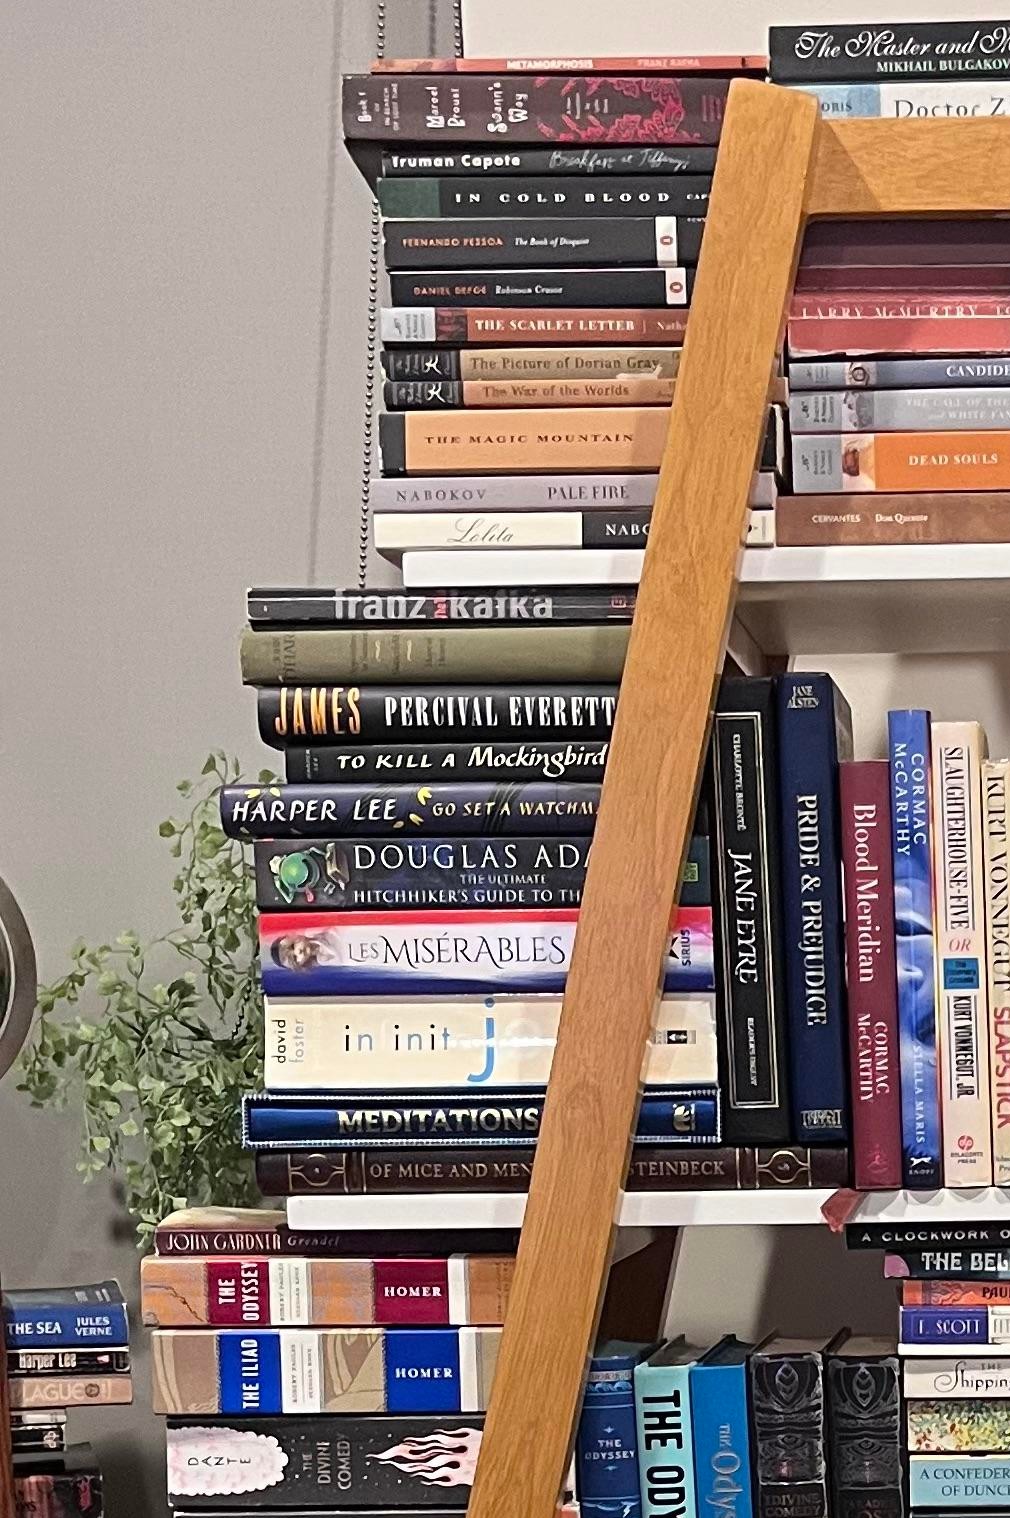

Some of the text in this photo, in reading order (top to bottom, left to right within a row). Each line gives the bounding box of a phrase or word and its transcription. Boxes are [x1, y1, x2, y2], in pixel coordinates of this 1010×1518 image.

[794, 31, 840, 61] The
[845, 30, 931, 57] Master
[935, 30, 978, 55] and
[877, 58, 1010, 73] MIKHAIL BULGAKOV
[392, 154, 521, 168] Truman Capote
[456, 192, 670, 203] IN COLD BLOOD
[475, 319, 635, 331] THE SCARLET LETTER
[424, 433, 634, 445] THE MAGIC MOUNTAIN
[908, 453, 998, 466] DEAD SOULS
[274, 687, 615, 736] JAMES PERCIVAL EVERETT
[337, 747, 607, 777] TO KILL A Mockingbird
[232, 799, 396, 822] HARPER LEE
[944, 746, 970, 930] SLAUGHTERHOUSE-FIVE
[355, 843, 517, 870] DOUGLAS
[853, 803, 876, 983] Blood Meridian
[728, 848, 758, 984] JANE EYRE
[796, 793, 827, 1027] PRIDE & PREJUDICE
[348, 943, 380, 962] LES
[338, 1108, 539, 1134] MEDITATIONS
[861, 1231, 871, 1242] A
[881, 1229, 990, 1242] CLOCKWORK
[921, 1253, 965, 1271] THE
[384, 1286, 442, 1297] HOMER
[7, 1322, 63, 1335] THE SEA
[77, 1317, 110, 1326] JULES
[75, 1327, 112, 1336] VERNE
[19, 1353, 77, 1369] Harper Lee
[241, 1339, 259, 1409] THE ILIAD
[641, 1390, 683, 1451] THE
